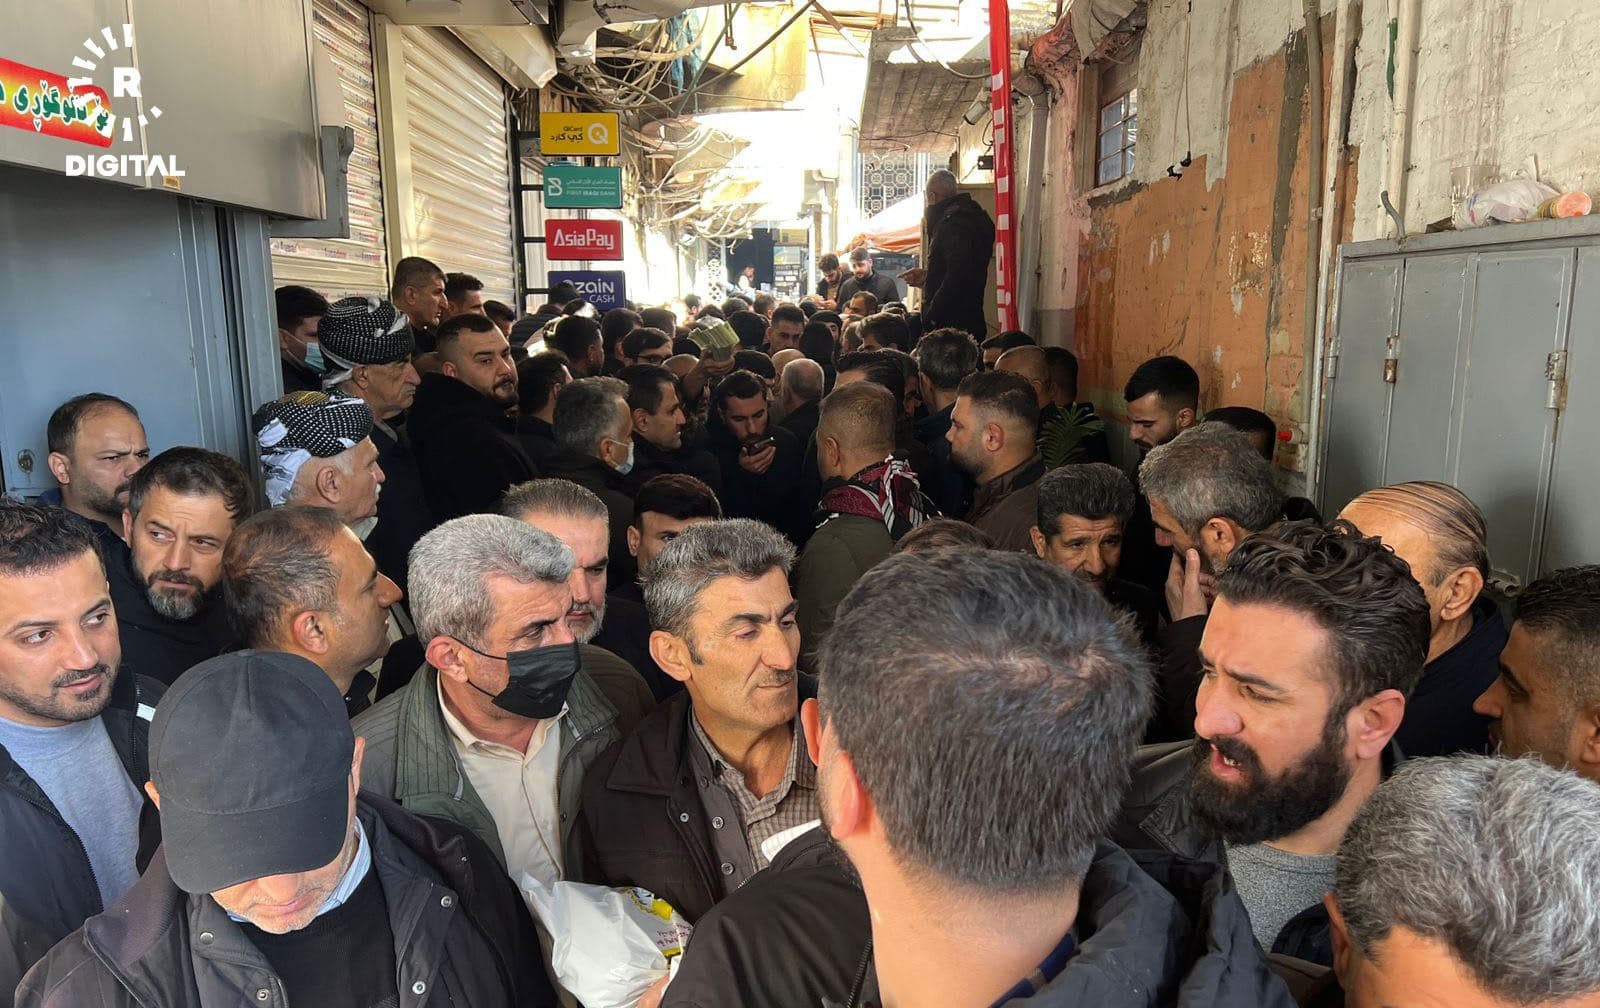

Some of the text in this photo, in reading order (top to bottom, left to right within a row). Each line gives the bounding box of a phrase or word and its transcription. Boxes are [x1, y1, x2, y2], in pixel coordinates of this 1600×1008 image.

[553, 228, 615, 251] AsiaPay
[574, 278, 615, 294] zain
[589, 294, 615, 303] CASH
